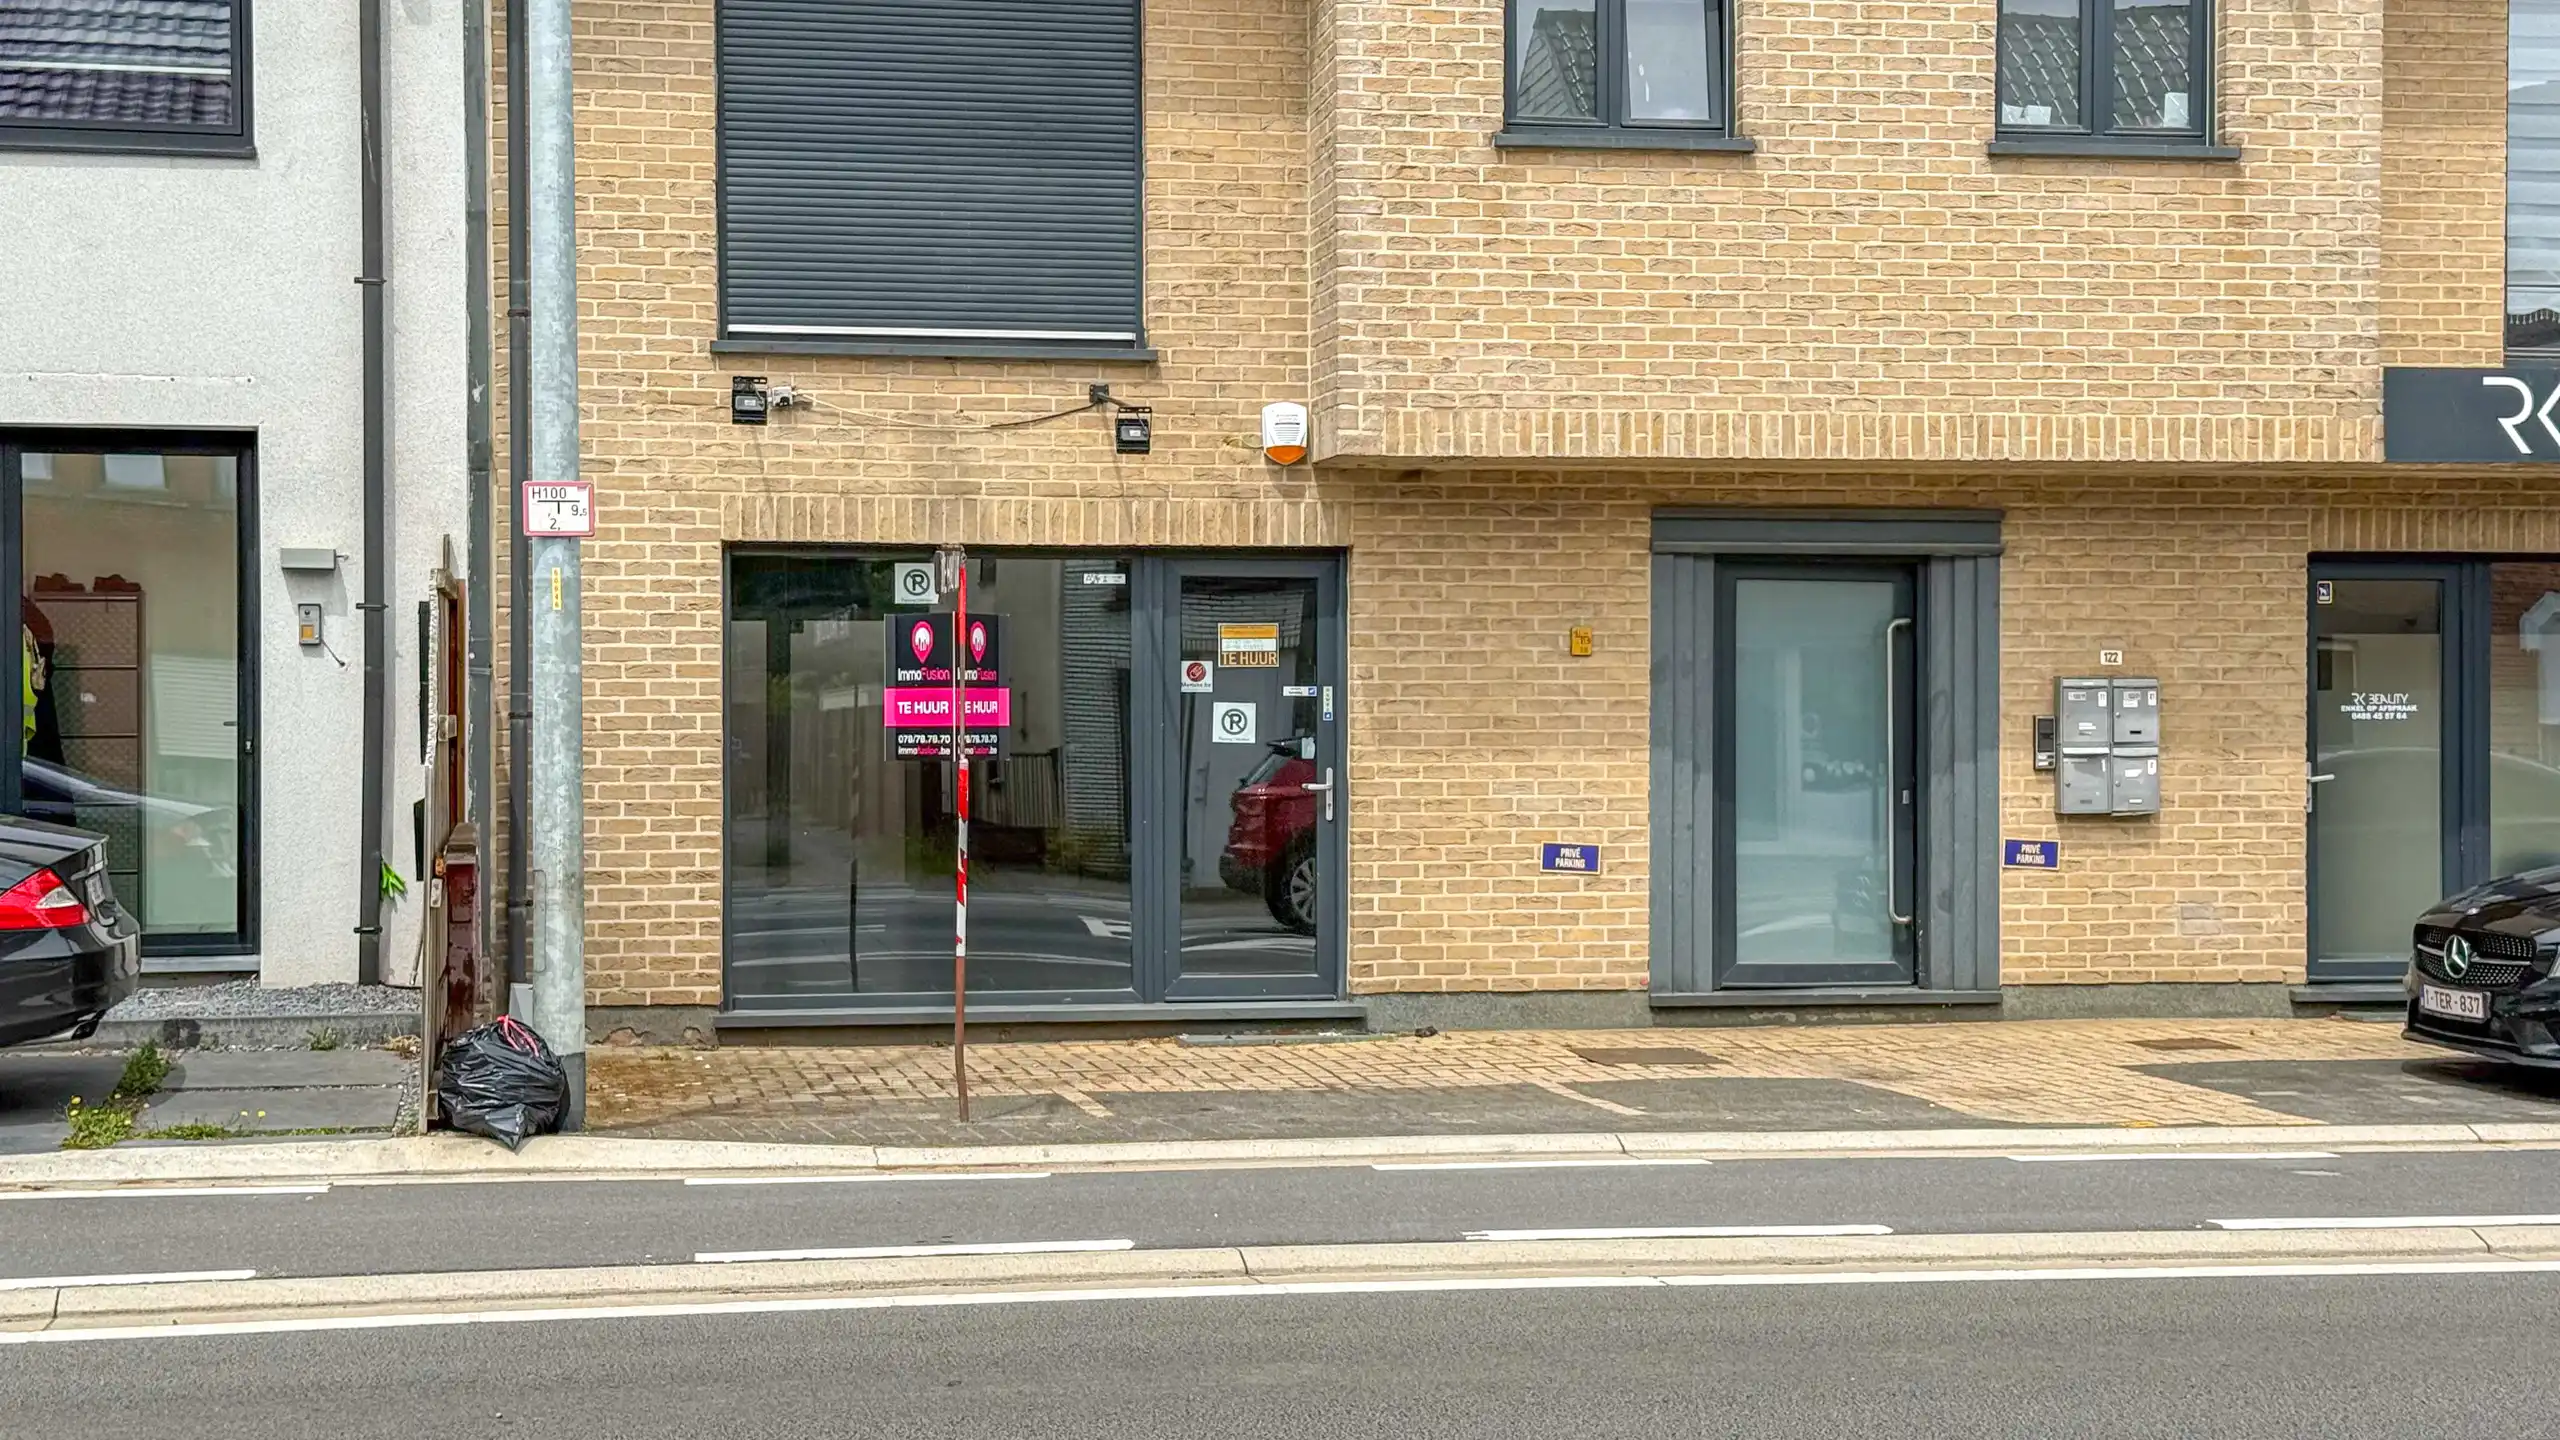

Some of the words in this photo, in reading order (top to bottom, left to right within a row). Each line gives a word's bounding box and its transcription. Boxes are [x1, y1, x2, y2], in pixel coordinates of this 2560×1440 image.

[531, 487, 567, 499] H100
[1222, 652, 1237, 665] TE
[1240, 652, 1277, 665] HUUR
[2104, 652, 2118, 663] 122
[897, 667, 951, 681] ImmoFusion
[2351, 692, 2366, 706] RK
[2368, 692, 2409, 705] BEAUTY
[897, 701, 912, 714] TE
[913, 701, 949, 714] HUUR
[972, 701, 998, 714] HUUR
[1560, 847, 1582, 857] PRIVÉ
[2021, 843, 2041, 854] PRIVÉ
[1555, 857, 1586, 869] PARKING
[2016, 853, 2045, 864] PARKING
